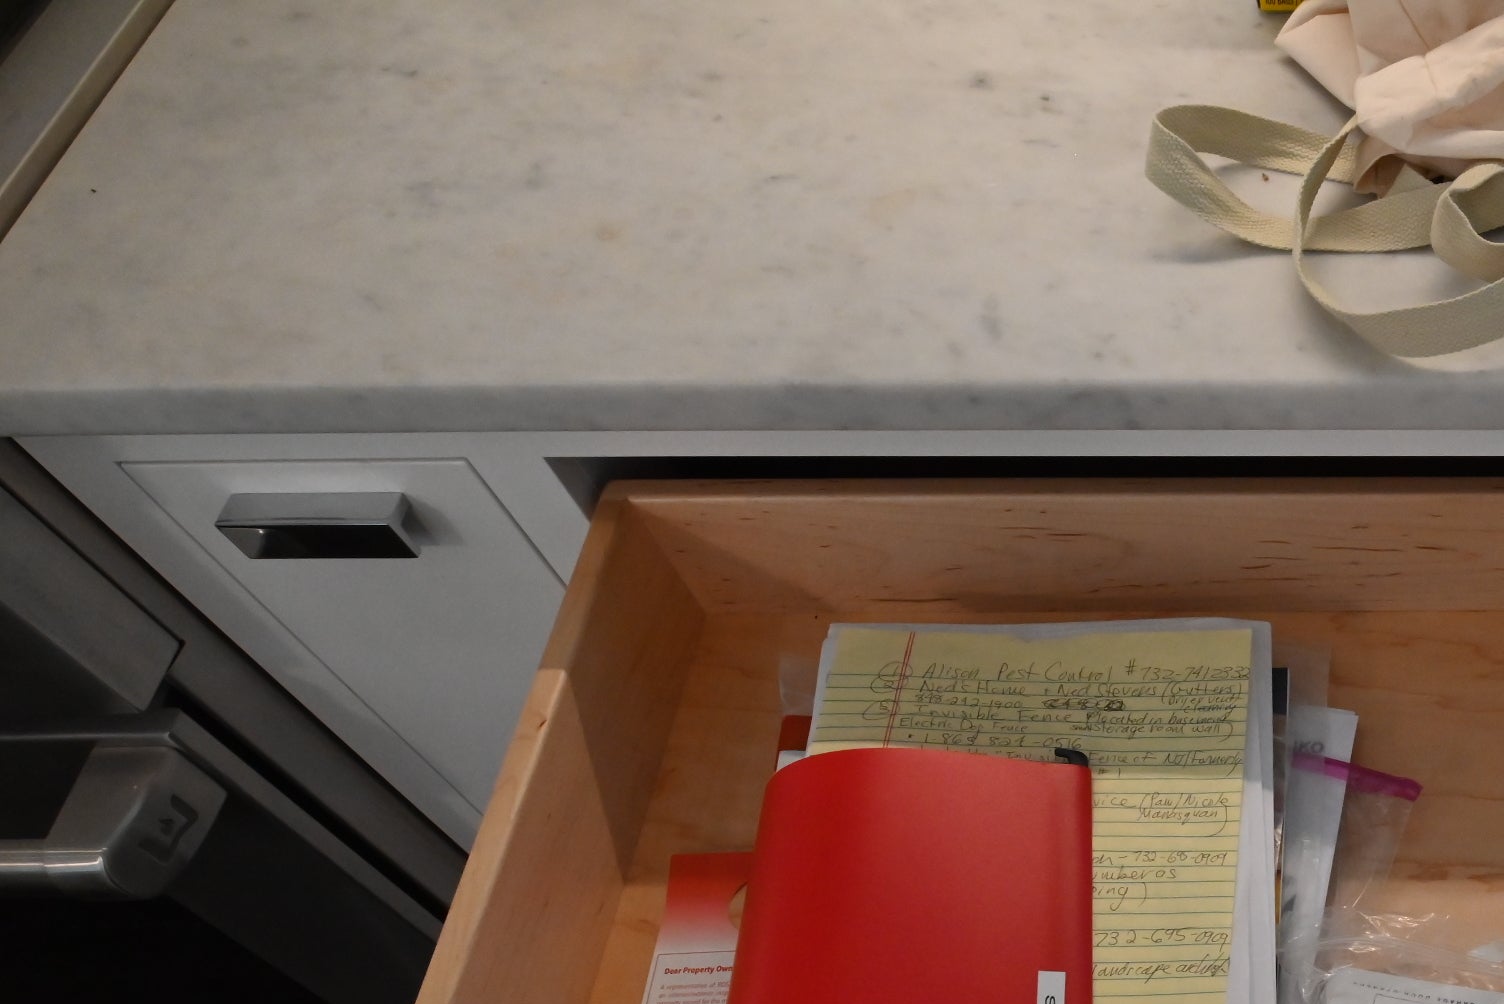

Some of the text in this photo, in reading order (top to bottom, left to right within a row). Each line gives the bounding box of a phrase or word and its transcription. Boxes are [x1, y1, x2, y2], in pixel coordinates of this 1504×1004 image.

[996, 661, 1041, 681] Pest
[1043, 659, 1113, 682] Control
[1057, 683, 1089, 697] Ned
[1017, 709, 1073, 723] Fence
[1092, 864, 1151, 881] umber
[664, 967, 682, 976] Dear
[682, 965, 715, 976] Property
